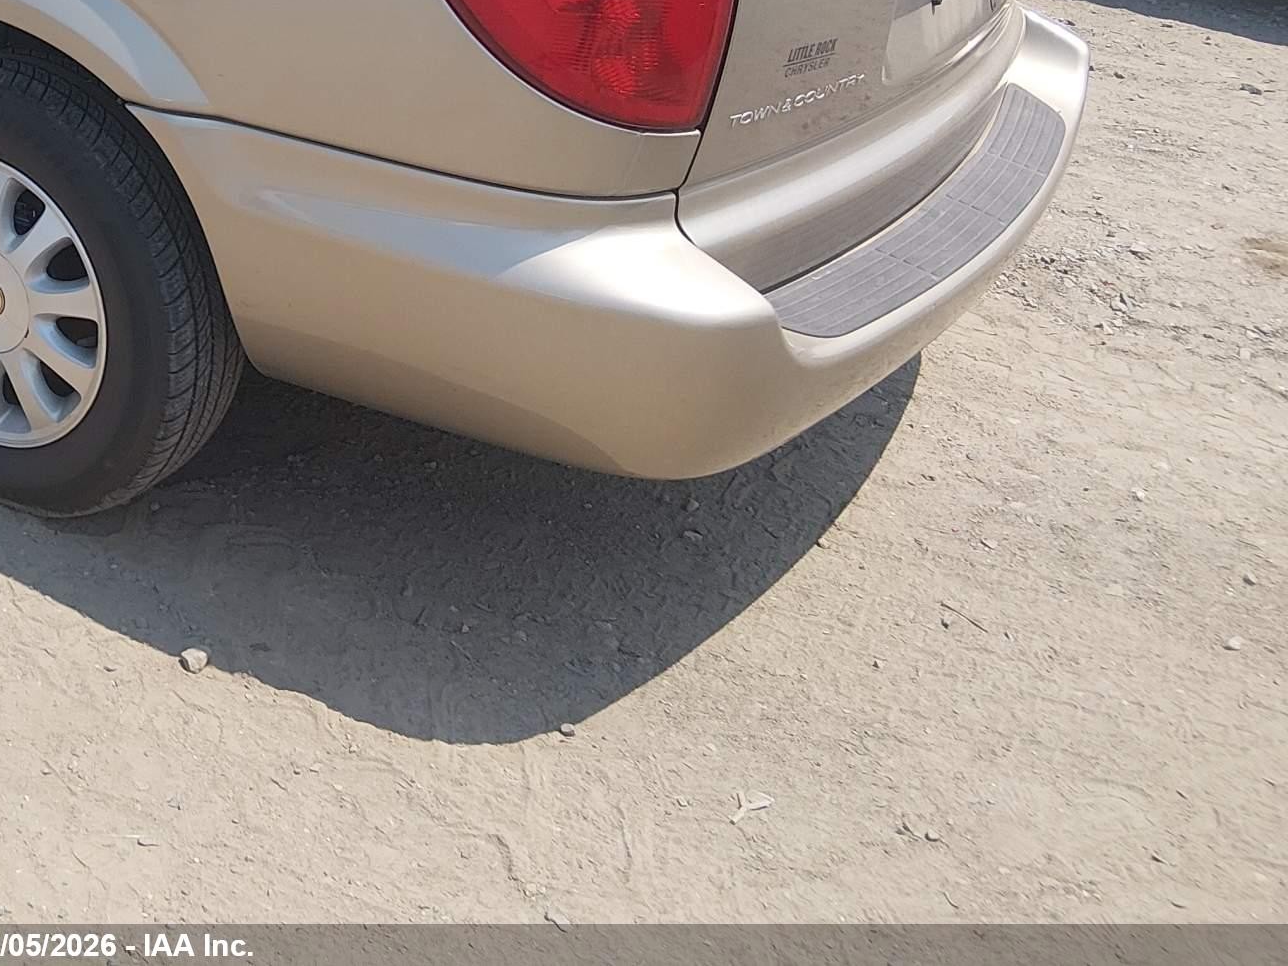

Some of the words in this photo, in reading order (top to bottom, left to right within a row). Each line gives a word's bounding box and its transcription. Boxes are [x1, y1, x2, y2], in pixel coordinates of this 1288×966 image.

[787, 45, 814, 62] LITTLE
[815, 38, 839, 56] ROCK
[784, 57, 831, 78] CHRYSLER
